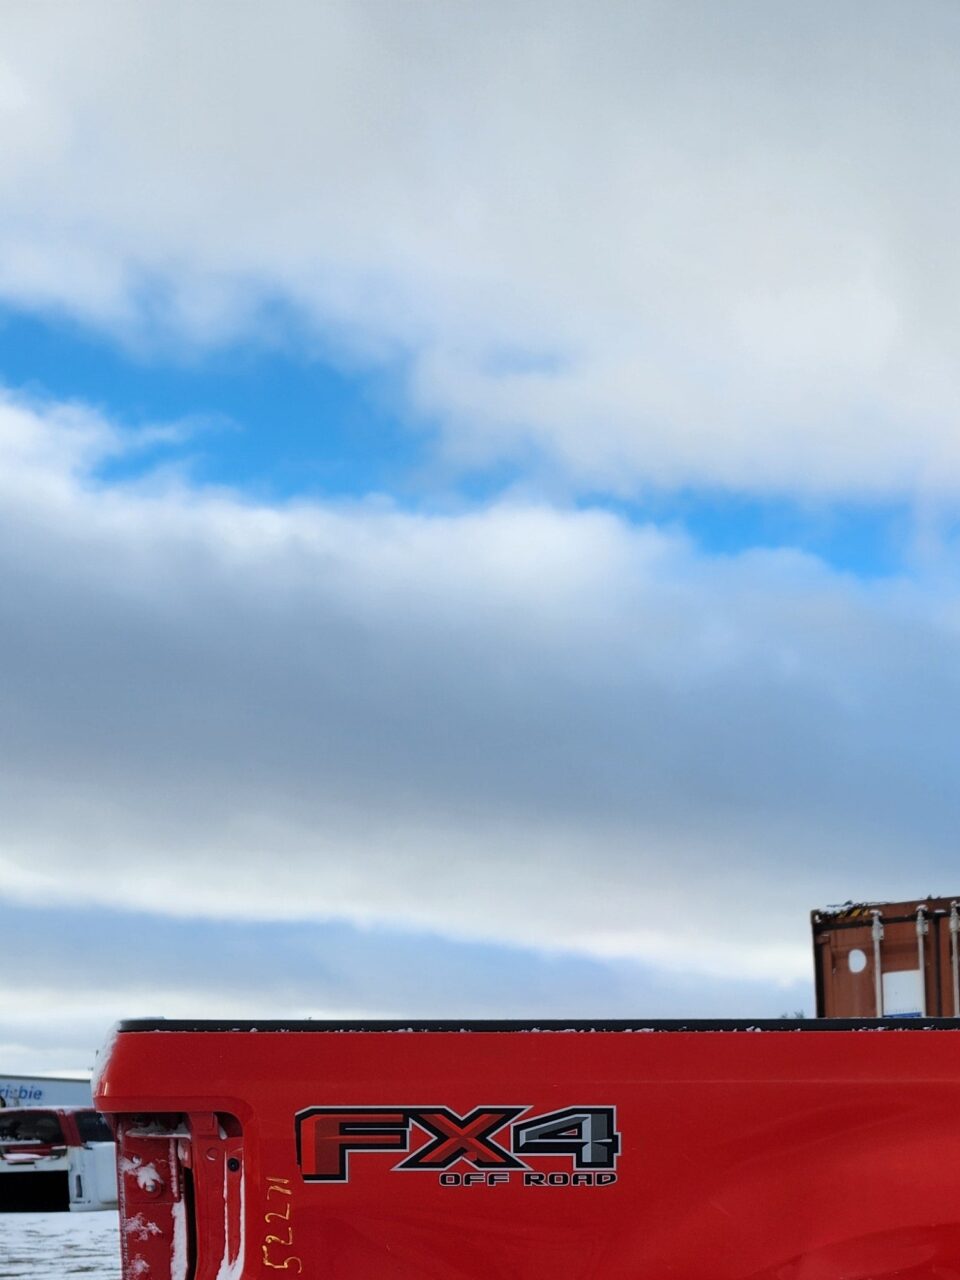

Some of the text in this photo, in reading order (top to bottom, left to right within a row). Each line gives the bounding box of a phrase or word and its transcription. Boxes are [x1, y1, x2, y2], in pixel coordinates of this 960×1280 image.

[294, 1105, 622, 1184] FX4
[438, 1171, 618, 1187] OFF ROAD
[262, 1176, 302, 1274] 52271
